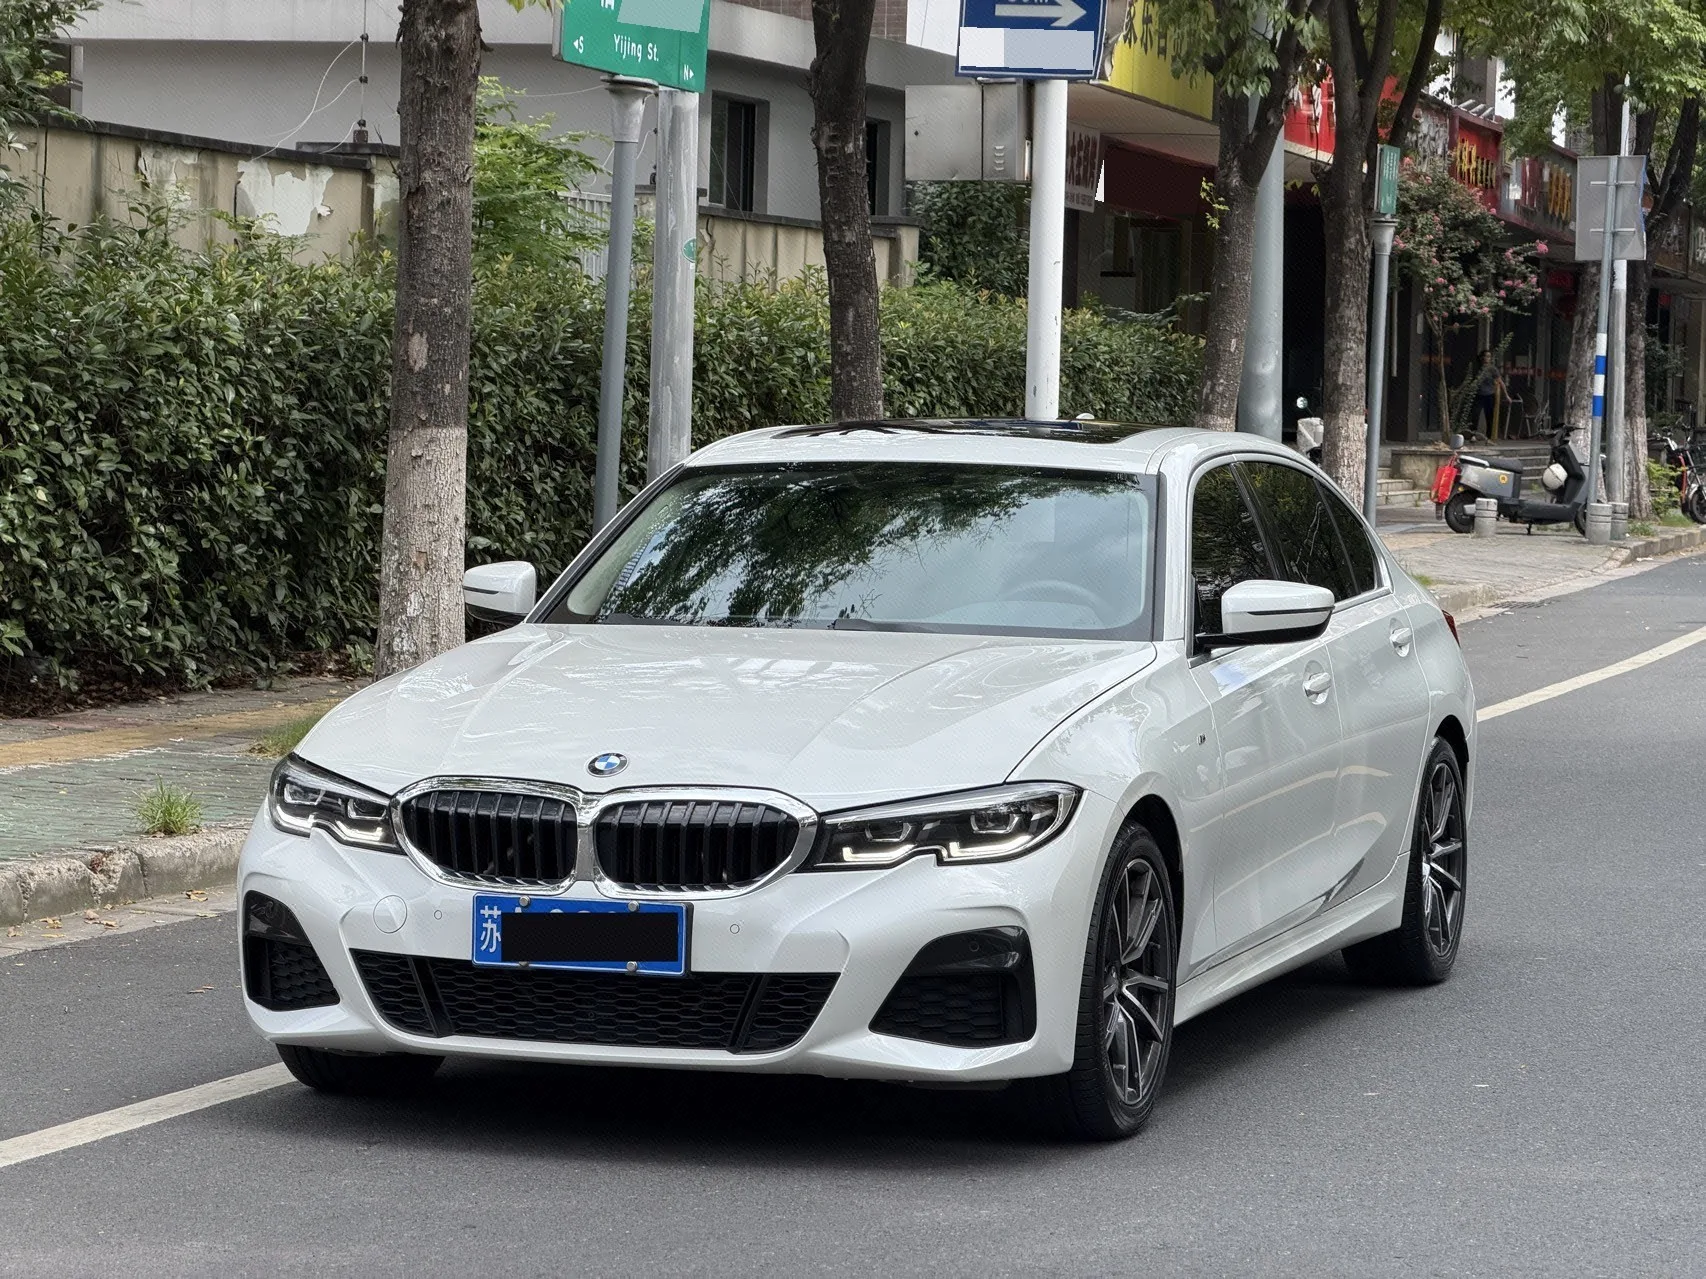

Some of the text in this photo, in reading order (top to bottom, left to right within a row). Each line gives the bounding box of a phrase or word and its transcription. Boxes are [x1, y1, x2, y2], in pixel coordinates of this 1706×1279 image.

[578, 35, 584, 54] S
[613, 33, 659, 63] Yijing St.
[683, 64, 689, 81] N
[480, 905, 502, 953] 苏
